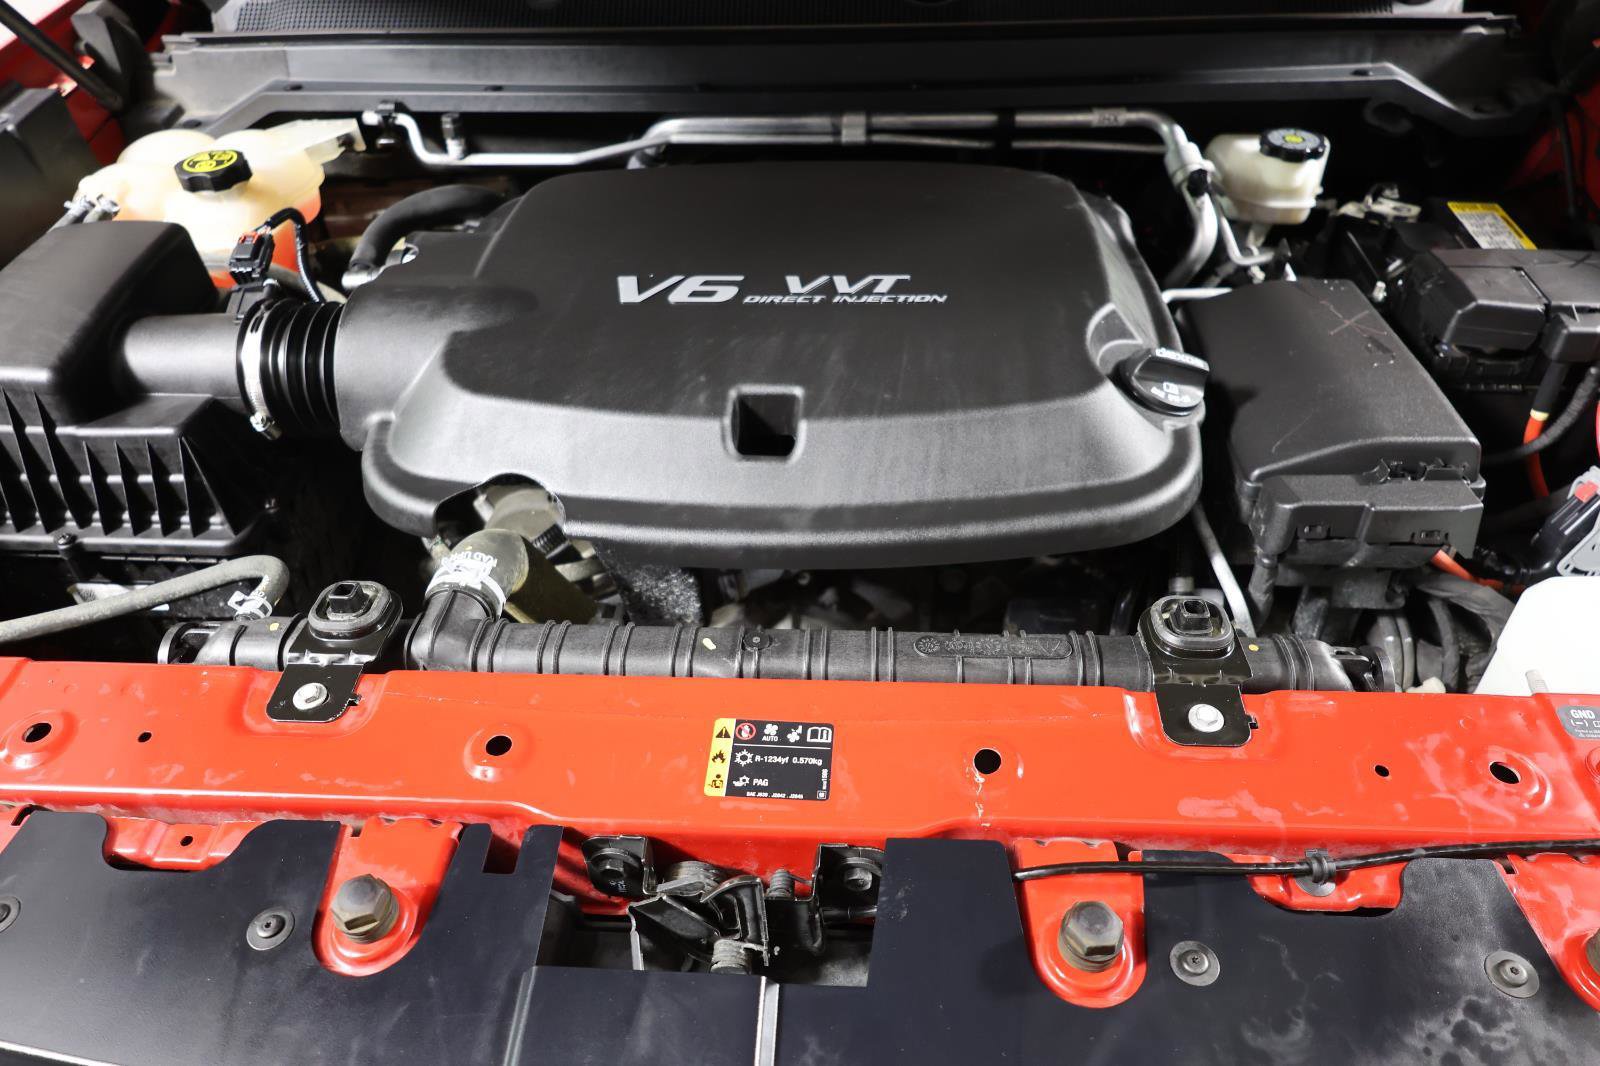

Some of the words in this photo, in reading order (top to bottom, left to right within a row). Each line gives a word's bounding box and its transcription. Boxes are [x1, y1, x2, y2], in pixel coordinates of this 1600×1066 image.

[617, 275, 745, 304] V6
[785, 275, 911, 294] VVT
[743, 295, 826, 304] DIRECT
[832, 295, 948, 304] INJECTION
[1570, 709, 1595, 719] GND
[755, 755, 789, 764] R-1234yf
[792, 756, 823, 766] 0.570kg
